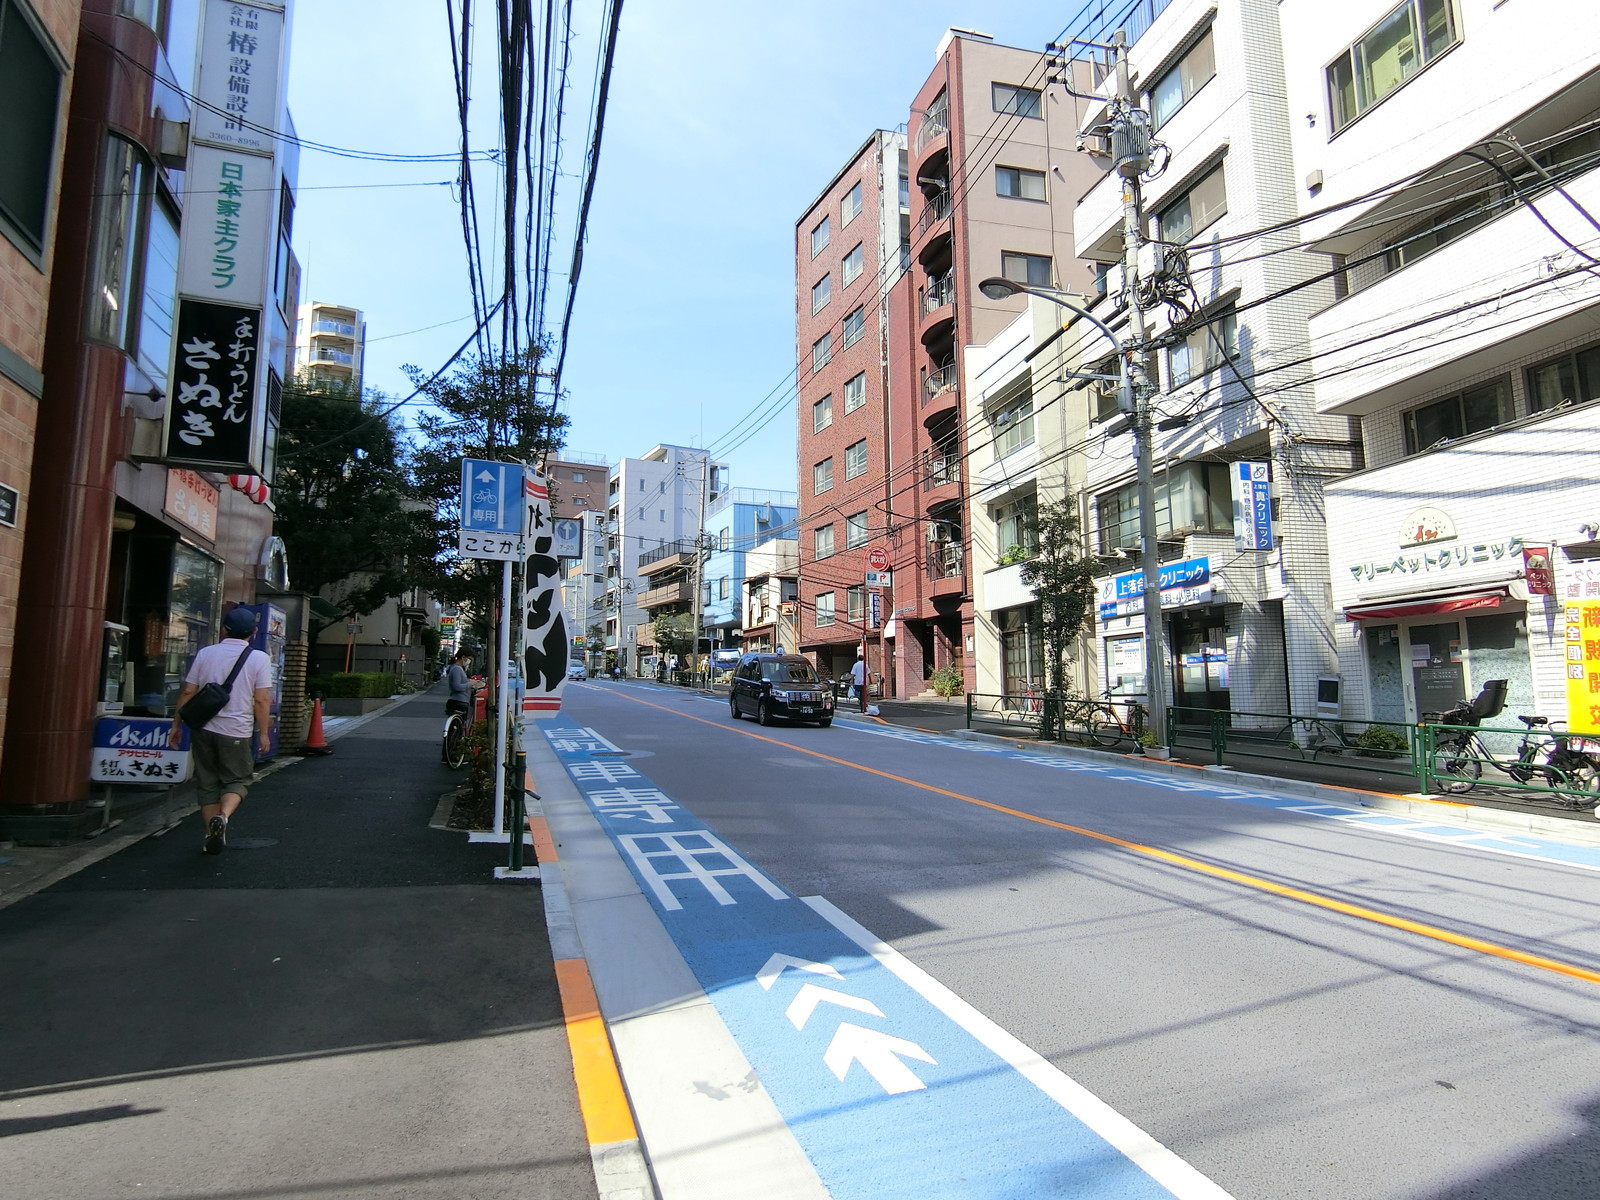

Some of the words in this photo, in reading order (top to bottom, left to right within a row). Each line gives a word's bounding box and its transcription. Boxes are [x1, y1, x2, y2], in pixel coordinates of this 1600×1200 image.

[224, 31, 258, 132] 椿設備設計
[208, 132, 260, 147] 3360-8996
[211, 161, 244, 289] 日本家主クラブ
[222, 316, 255, 423] 手打うどん
[178, 336, 223, 446] さぬき
[174, 488, 211, 533] さぬき
[472, 509, 497, 522] 専用
[1255, 491, 1269, 547] 真クリニック
[1350, 536, 1525, 582] マリーペットクリニック
[1119, 565, 1204, 596] 上落合クリニック
[109, 724, 173, 748] Asahi
[100, 759, 120, 768] 手打
[117, 749, 164, 759] アサヒビール
[127, 759, 180, 779] さぬき
[101, 768, 125, 776] うどん
